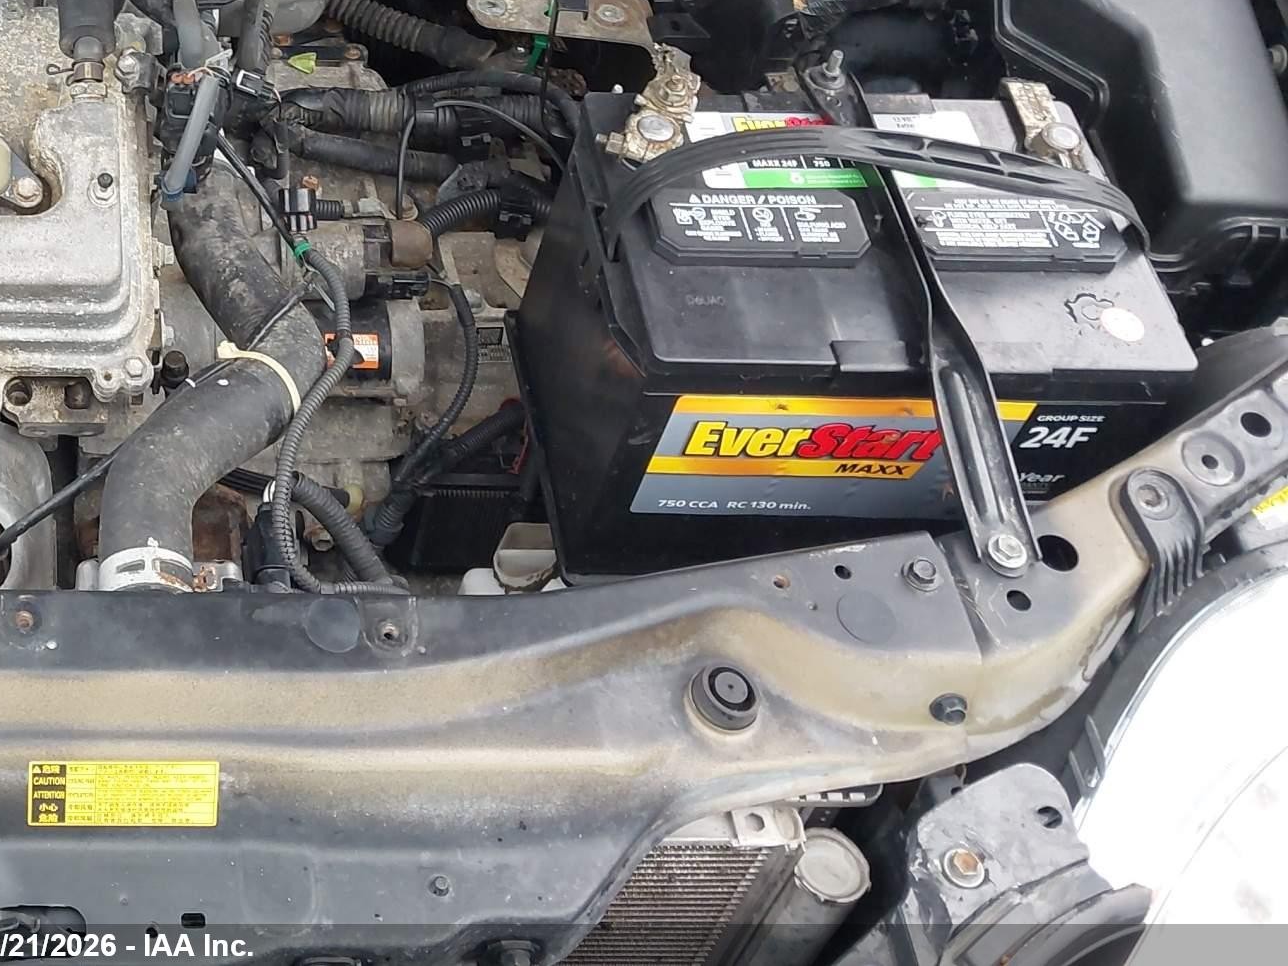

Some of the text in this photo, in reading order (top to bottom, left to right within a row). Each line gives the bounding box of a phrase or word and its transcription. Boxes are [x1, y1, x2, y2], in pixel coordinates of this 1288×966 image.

[703, 194, 817, 205] DANGER / POISON
[1036, 415, 1106, 423] GROUP SIZE
[683, 420, 942, 461] EverStart
[1019, 426, 1098, 449] 24F
[834, 463, 910, 476] MAXX
[657, 499, 812, 511] 750 CCA RC 130 min.
[33, 776, 66, 786] CAUTION
[33, 790, 65, 800] ATTENTION
